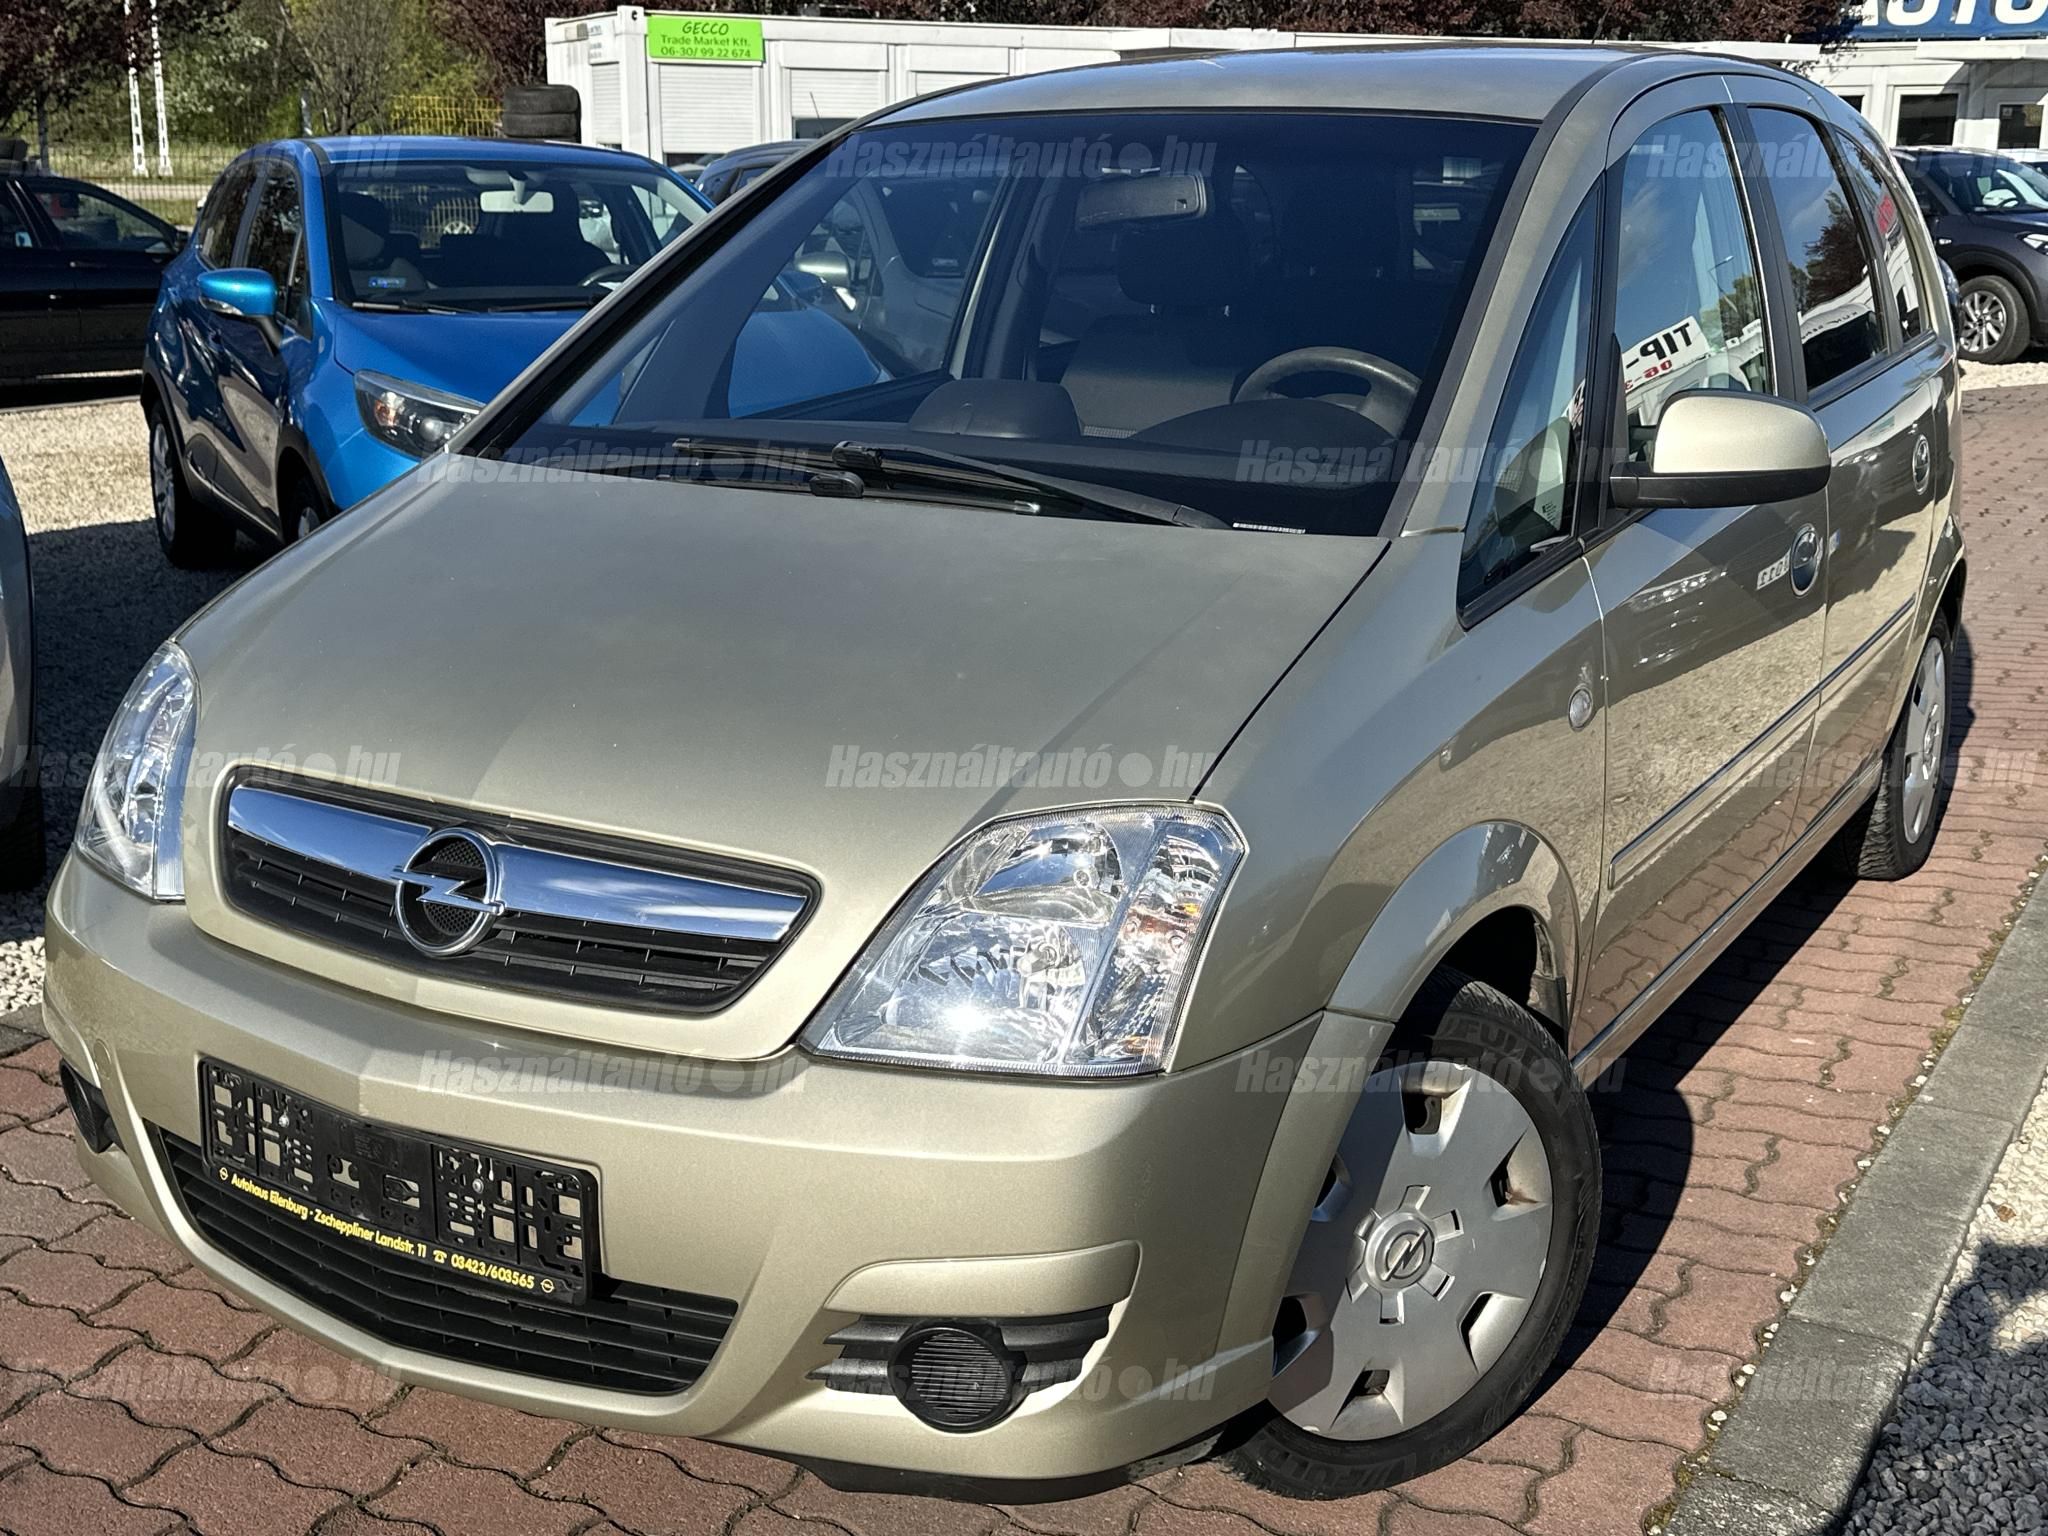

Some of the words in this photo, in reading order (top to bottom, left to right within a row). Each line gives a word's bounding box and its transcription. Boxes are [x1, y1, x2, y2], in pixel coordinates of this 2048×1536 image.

[682, 21, 729, 35] GECCO
[661, 35, 691, 45] Trade
[694, 36, 731, 46] Market
[733, 37, 750, 47] Kft.
[661, 46, 696, 57] 06-30/
[701, 47, 715, 57] 99
[717, 48, 731, 58] 22
[732, 48, 751, 58] 674
[231, 1174, 269, 1200] Autohaus
[269, 1191, 309, 1220] Eilenburg
[314, 1209, 374, 1241] Zscheppliner
[375, 1231, 414, 1254] Landstr.
[417, 1243, 427, 1257] 11
[451, 1254, 535, 1289] 03423/603565
